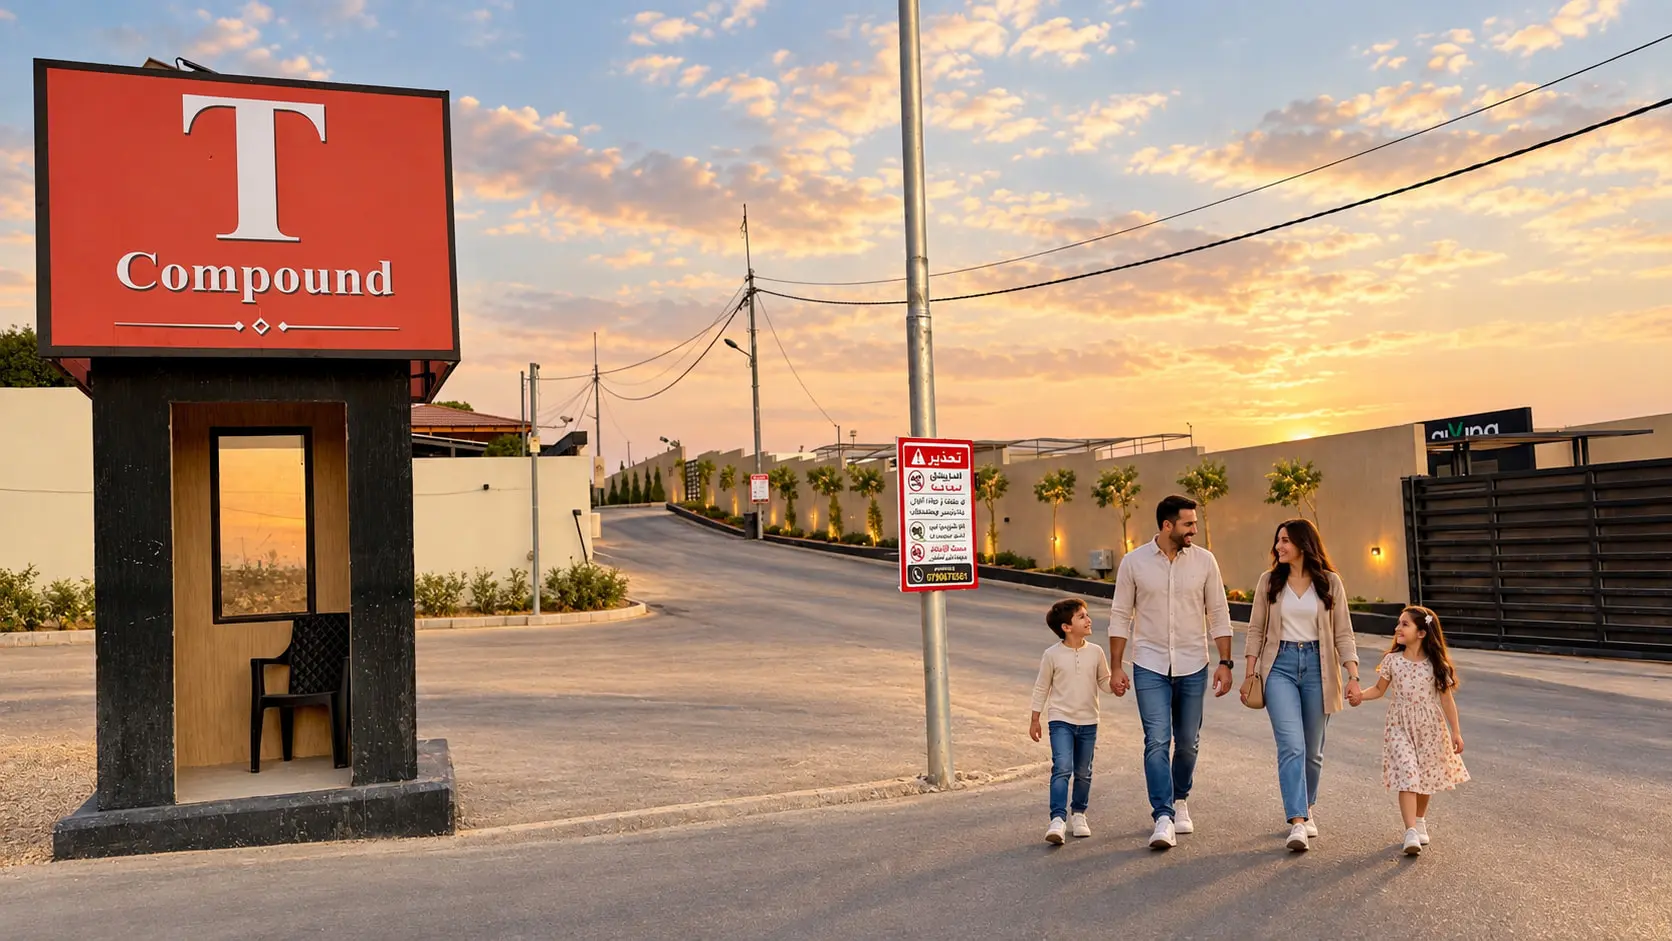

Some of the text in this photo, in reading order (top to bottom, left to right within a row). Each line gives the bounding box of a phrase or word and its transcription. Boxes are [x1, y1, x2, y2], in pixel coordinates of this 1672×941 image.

[182, 94, 326, 242] T
[116, 251, 395, 304] Compound
[928, 451, 962, 466] تحذير
